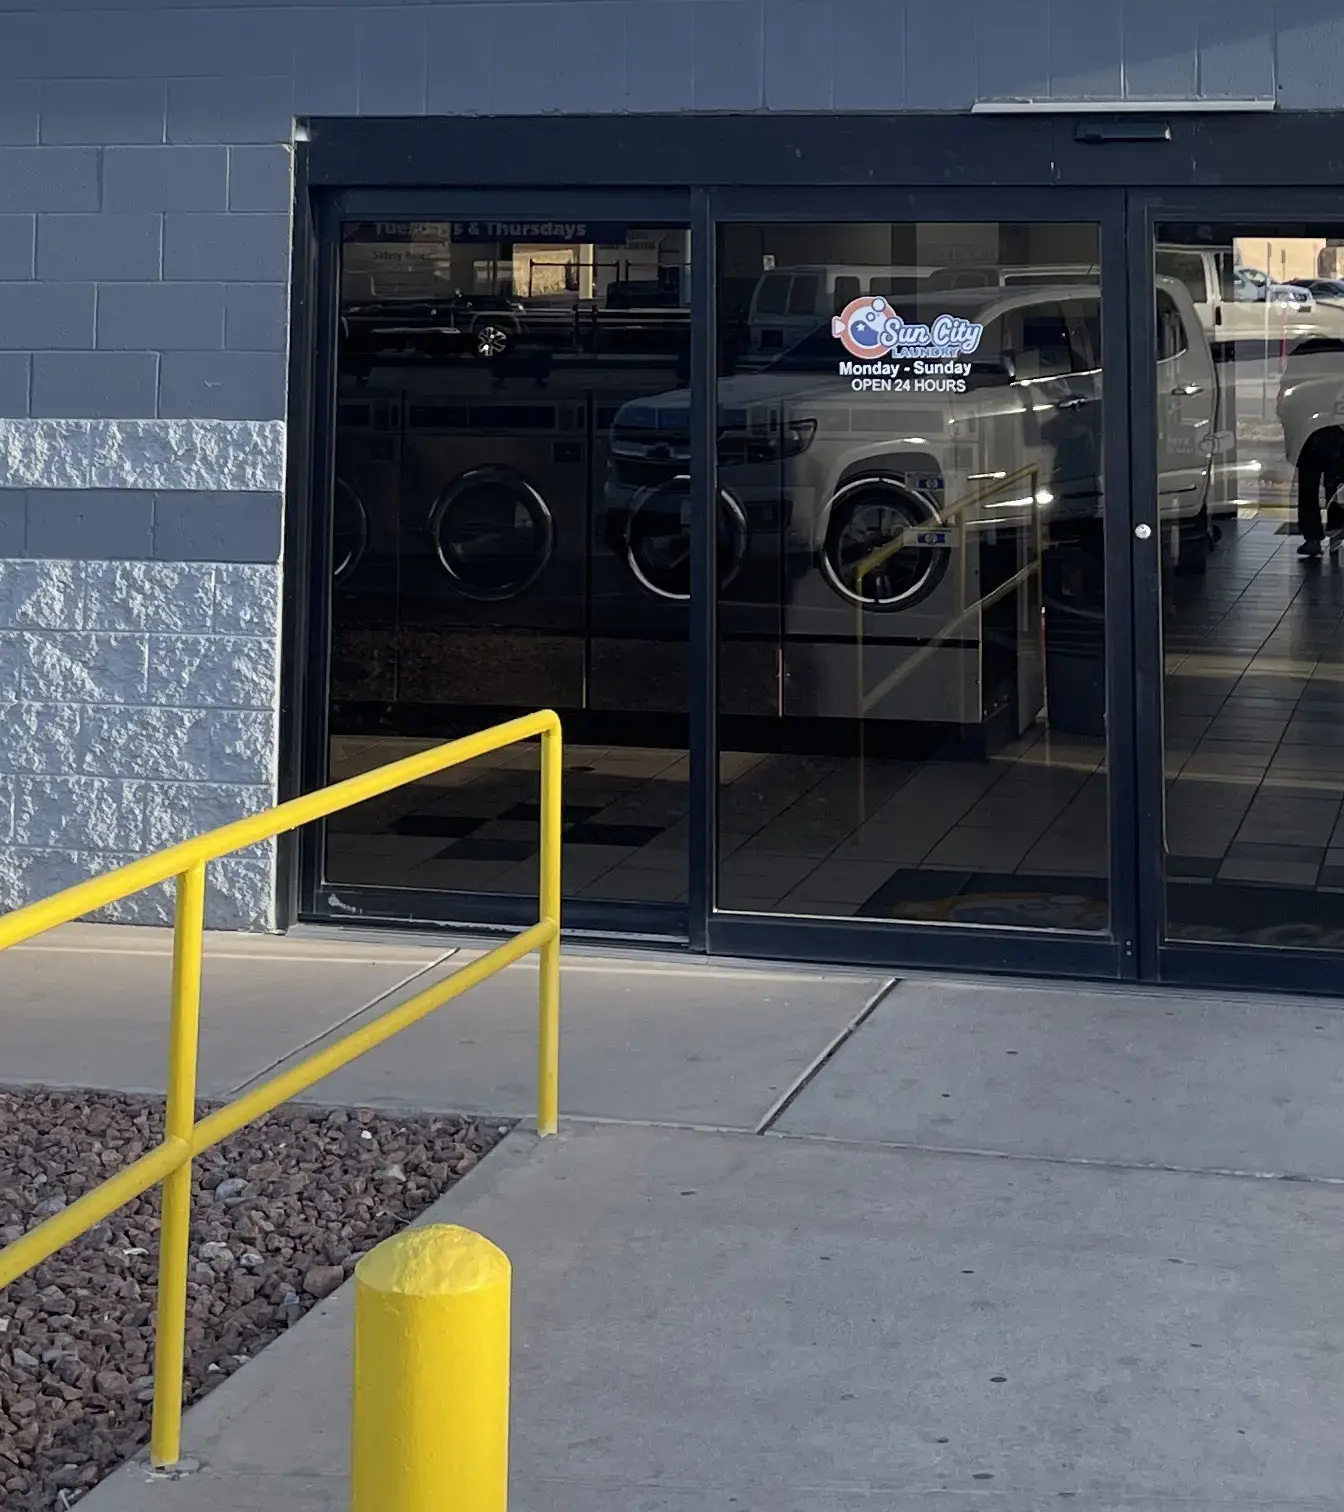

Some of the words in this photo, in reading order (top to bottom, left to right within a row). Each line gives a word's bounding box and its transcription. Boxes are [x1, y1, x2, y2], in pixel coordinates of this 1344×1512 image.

[375, 222, 463, 239] Tues
[468, 222, 480, 236] &
[486, 221, 587, 241] Thursdays
[880, 317, 931, 347] Sun
[932, 315, 983, 353] City
[892, 346, 959, 359] LAUNDRY
[839, 361, 900, 378] Monday
[913, 360, 972, 376] Sunday
[851, 378, 892, 392] OPEN
[894, 378, 911, 392] 24
[914, 378, 967, 393] HOURS
